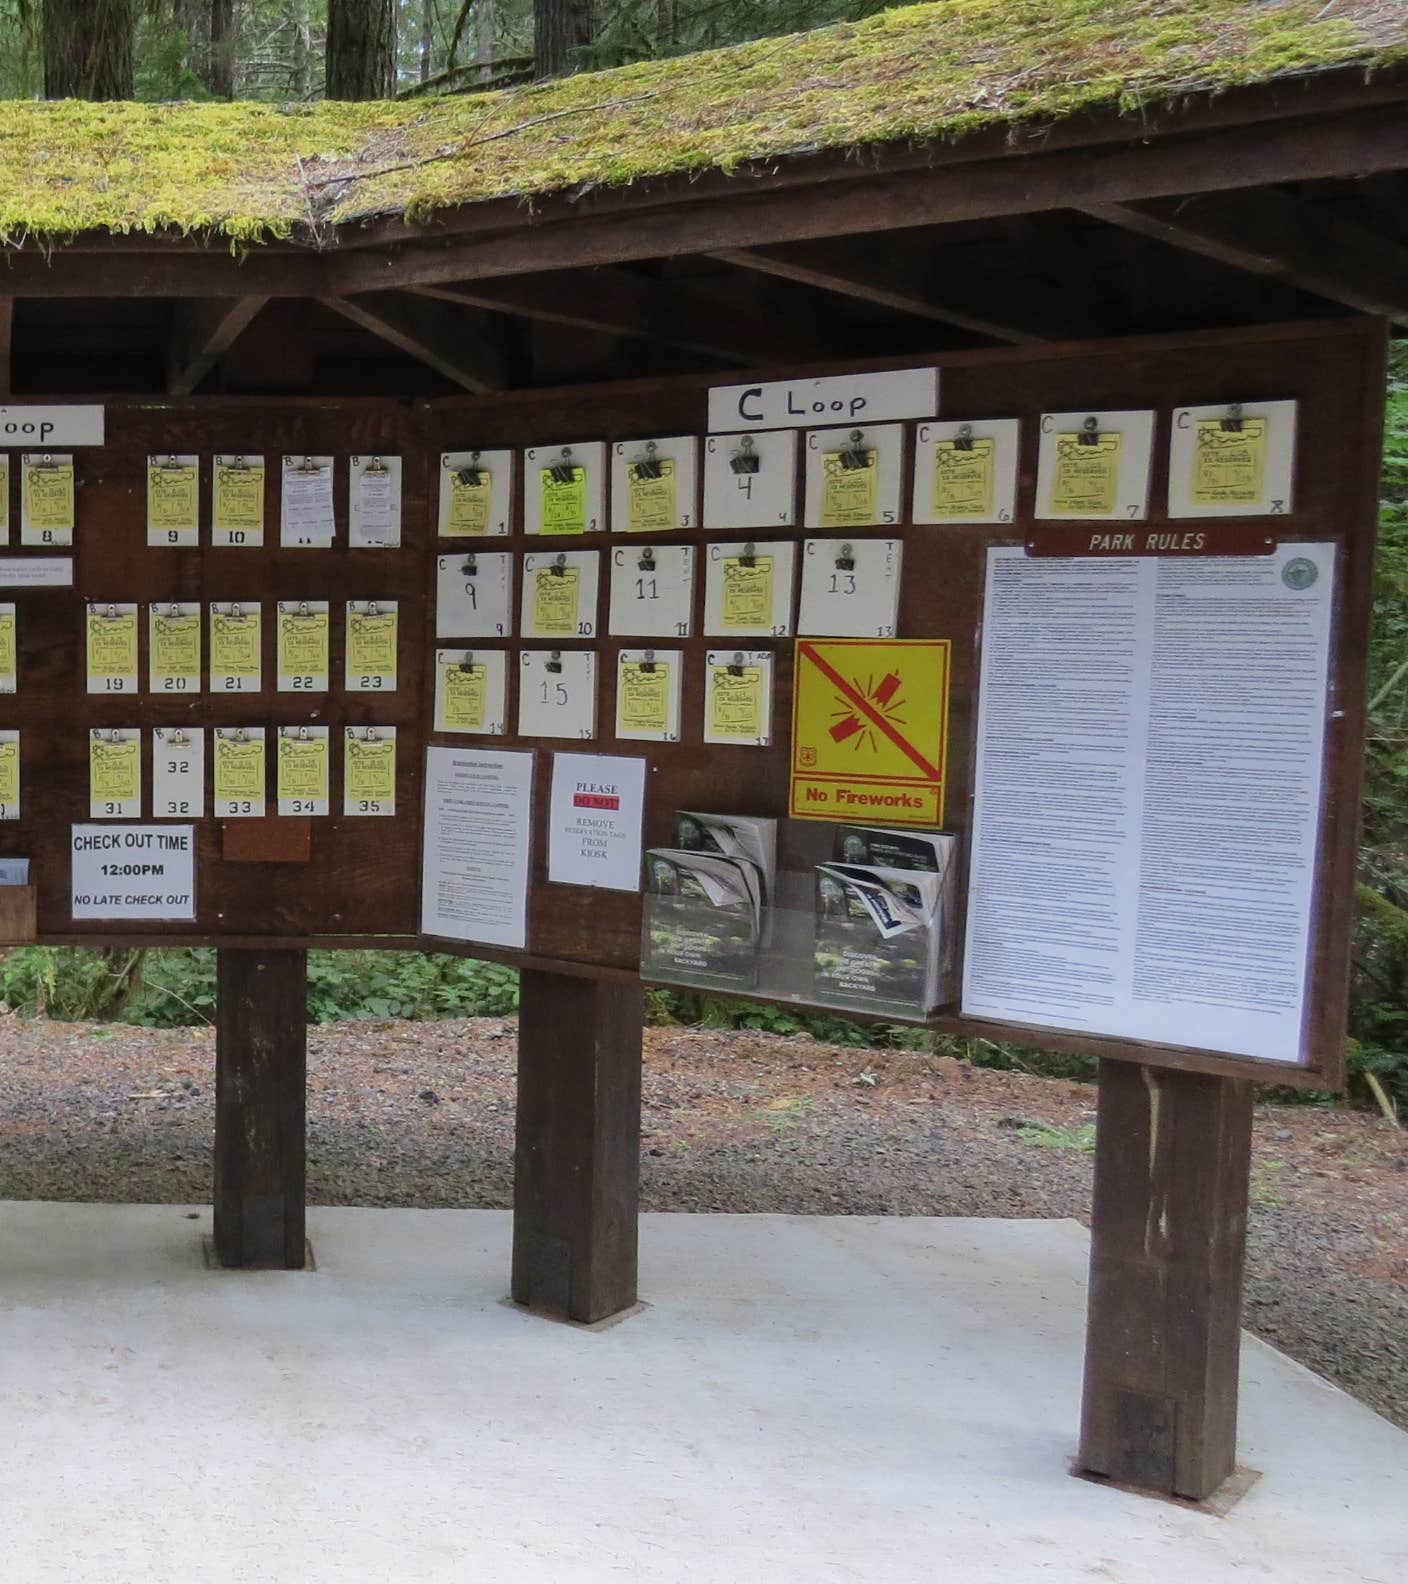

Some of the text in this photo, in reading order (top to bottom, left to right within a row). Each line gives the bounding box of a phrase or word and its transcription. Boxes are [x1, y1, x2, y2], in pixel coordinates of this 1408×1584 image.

[738, 388, 867, 421] C Loop
[1042, 416, 1054, 434] C
[1178, 412, 1190, 430] C
[920, 427, 929, 443] C
[708, 439, 716, 453] C
[809, 435, 818, 450] C
[527, 450, 536, 460] C
[617, 444, 624, 455] C
[443, 456, 450, 468] C
[738, 476, 752, 500] 4
[779, 512, 787, 522] 4
[999, 508, 1010, 522] 6
[1127, 504, 1140, 518] 7
[681, 515, 689, 527] 3
[883, 511, 894, 524] 5
[42, 530, 52, 542] 8
[168, 531, 178, 542] 9
[228, 531, 245, 543] 10
[1089, 532, 1207, 551] PARK RULES
[711, 547, 720, 560] C
[808, 543, 815, 555] C
[439, 559, 447, 570] C
[526, 557, 535, 572] C
[615, 551, 624, 566] C
[636, 578, 659, 599] 11
[828, 574, 856, 595] 13
[465, 583, 477, 610] 9
[496, 623, 503, 636] 9
[578, 622, 592, 635] 10
[674, 623, 688, 636] 11
[771, 626, 786, 636] 12
[878, 626, 892, 637] 13
[522, 653, 530, 666] C
[708, 654, 715, 665] C
[105, 678, 123, 690] 19
[164, 678, 186, 689] 20
[225, 677, 242, 689] 21
[293, 677, 313, 689] 22
[361, 676, 382, 688] 23
[541, 681, 568, 705] 15
[168, 761, 189, 773] 32
[576, 783, 618, 794] PLEASE
[806, 787, 924, 809] No Fireworks
[105, 803, 122, 814] 31
[168, 802, 189, 814] 32
[229, 802, 251, 813] 33
[293, 801, 314, 812] 34
[360, 801, 380, 812] 35
[576, 818, 615, 829] REMOVE
[73, 833, 188, 851] CHECK OUT TIME
[582, 838, 607, 847] FROM
[580, 849, 608, 859] KIOSK
[100, 864, 164, 876] 12:00PM
[74, 895, 190, 905] NO LATE CHECK OUT
